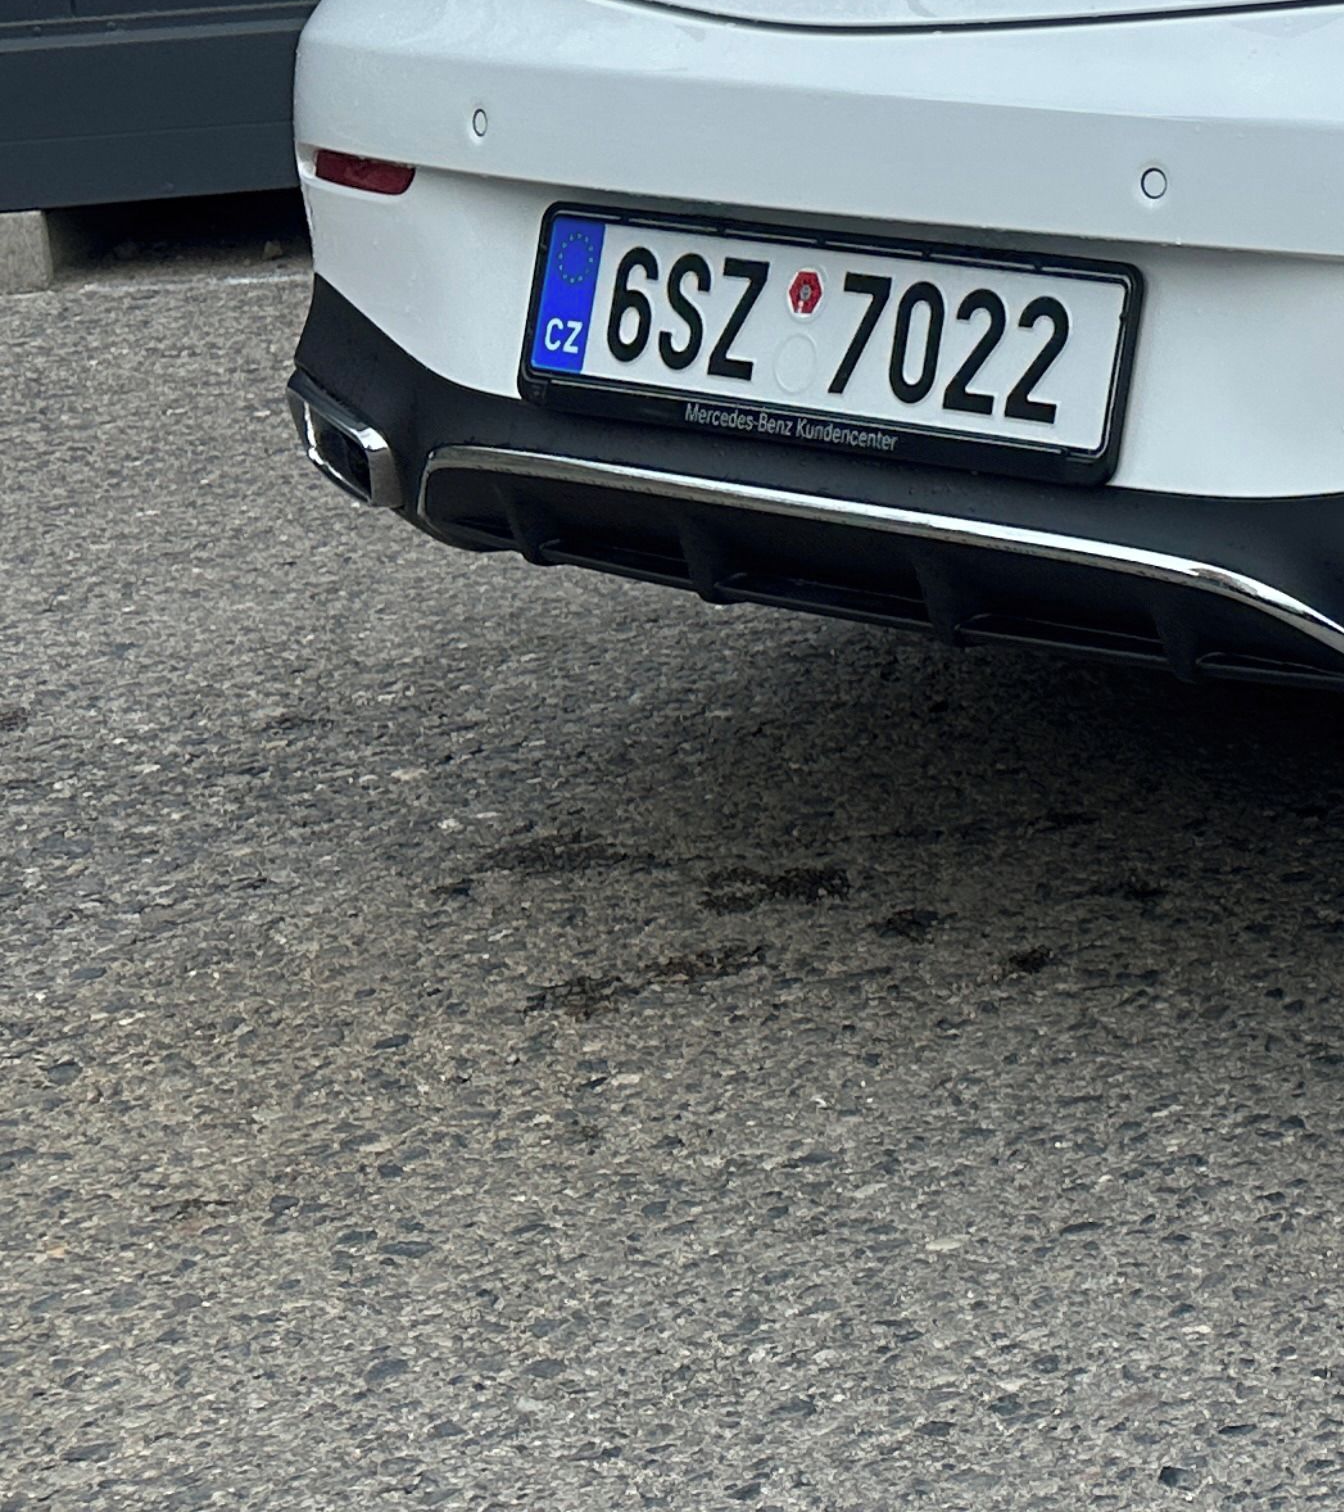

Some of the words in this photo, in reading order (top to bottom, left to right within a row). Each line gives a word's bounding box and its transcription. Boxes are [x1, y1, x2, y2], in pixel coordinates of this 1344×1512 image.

[544, 317, 583, 355] CZ
[606, 246, 770, 381] 6SZ
[827, 272, 1070, 425] 7022
[684, 402, 794, 436] Mercedes-Benz
[795, 417, 899, 451] Kundencenter
